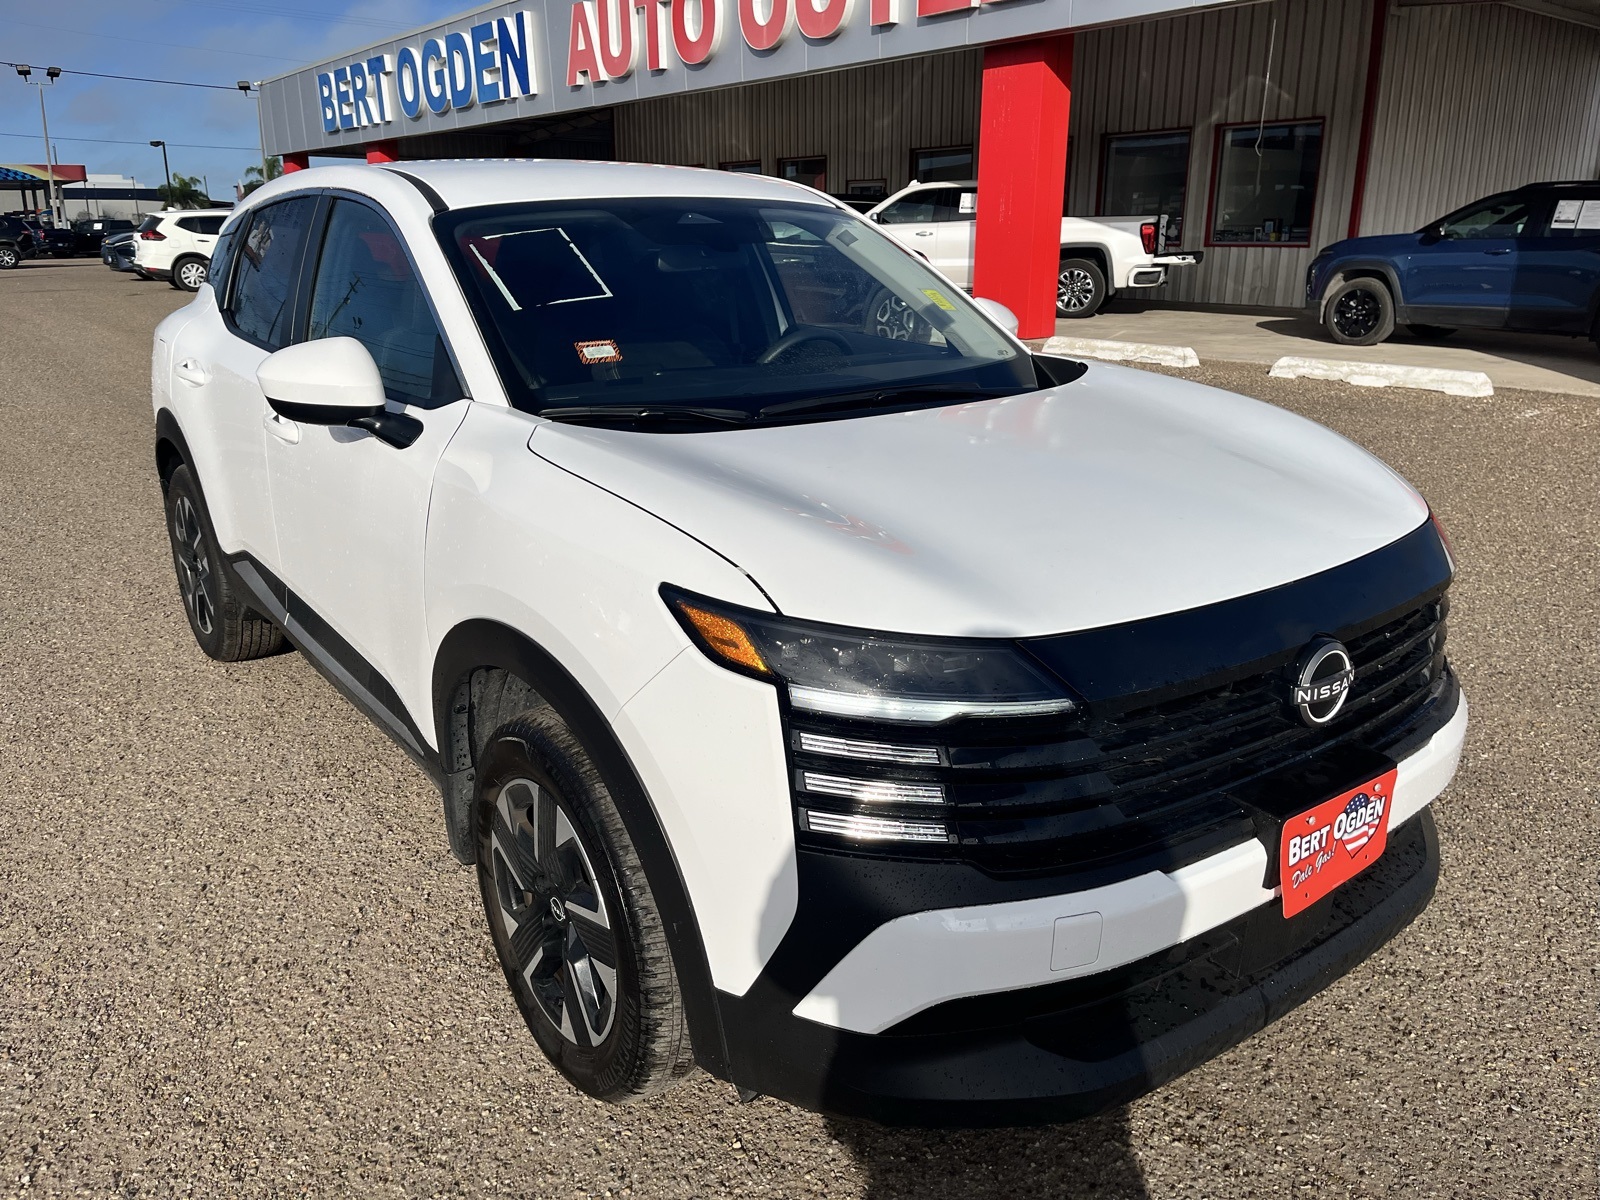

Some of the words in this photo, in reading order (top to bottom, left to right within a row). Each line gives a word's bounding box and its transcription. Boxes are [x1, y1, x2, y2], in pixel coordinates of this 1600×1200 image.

[317, 54, 393, 132] BERT
[398, 10, 537, 118] OGDEN
[566, 0, 723, 86] AUTO
[1297, 669, 1354, 702] NISSAN
[1288, 824, 1331, 867] BERT
[1333, 796, 1386, 840] OGDEN
[1291, 864, 1313, 889] Dale
[1315, 840, 1337, 873] Gas!
